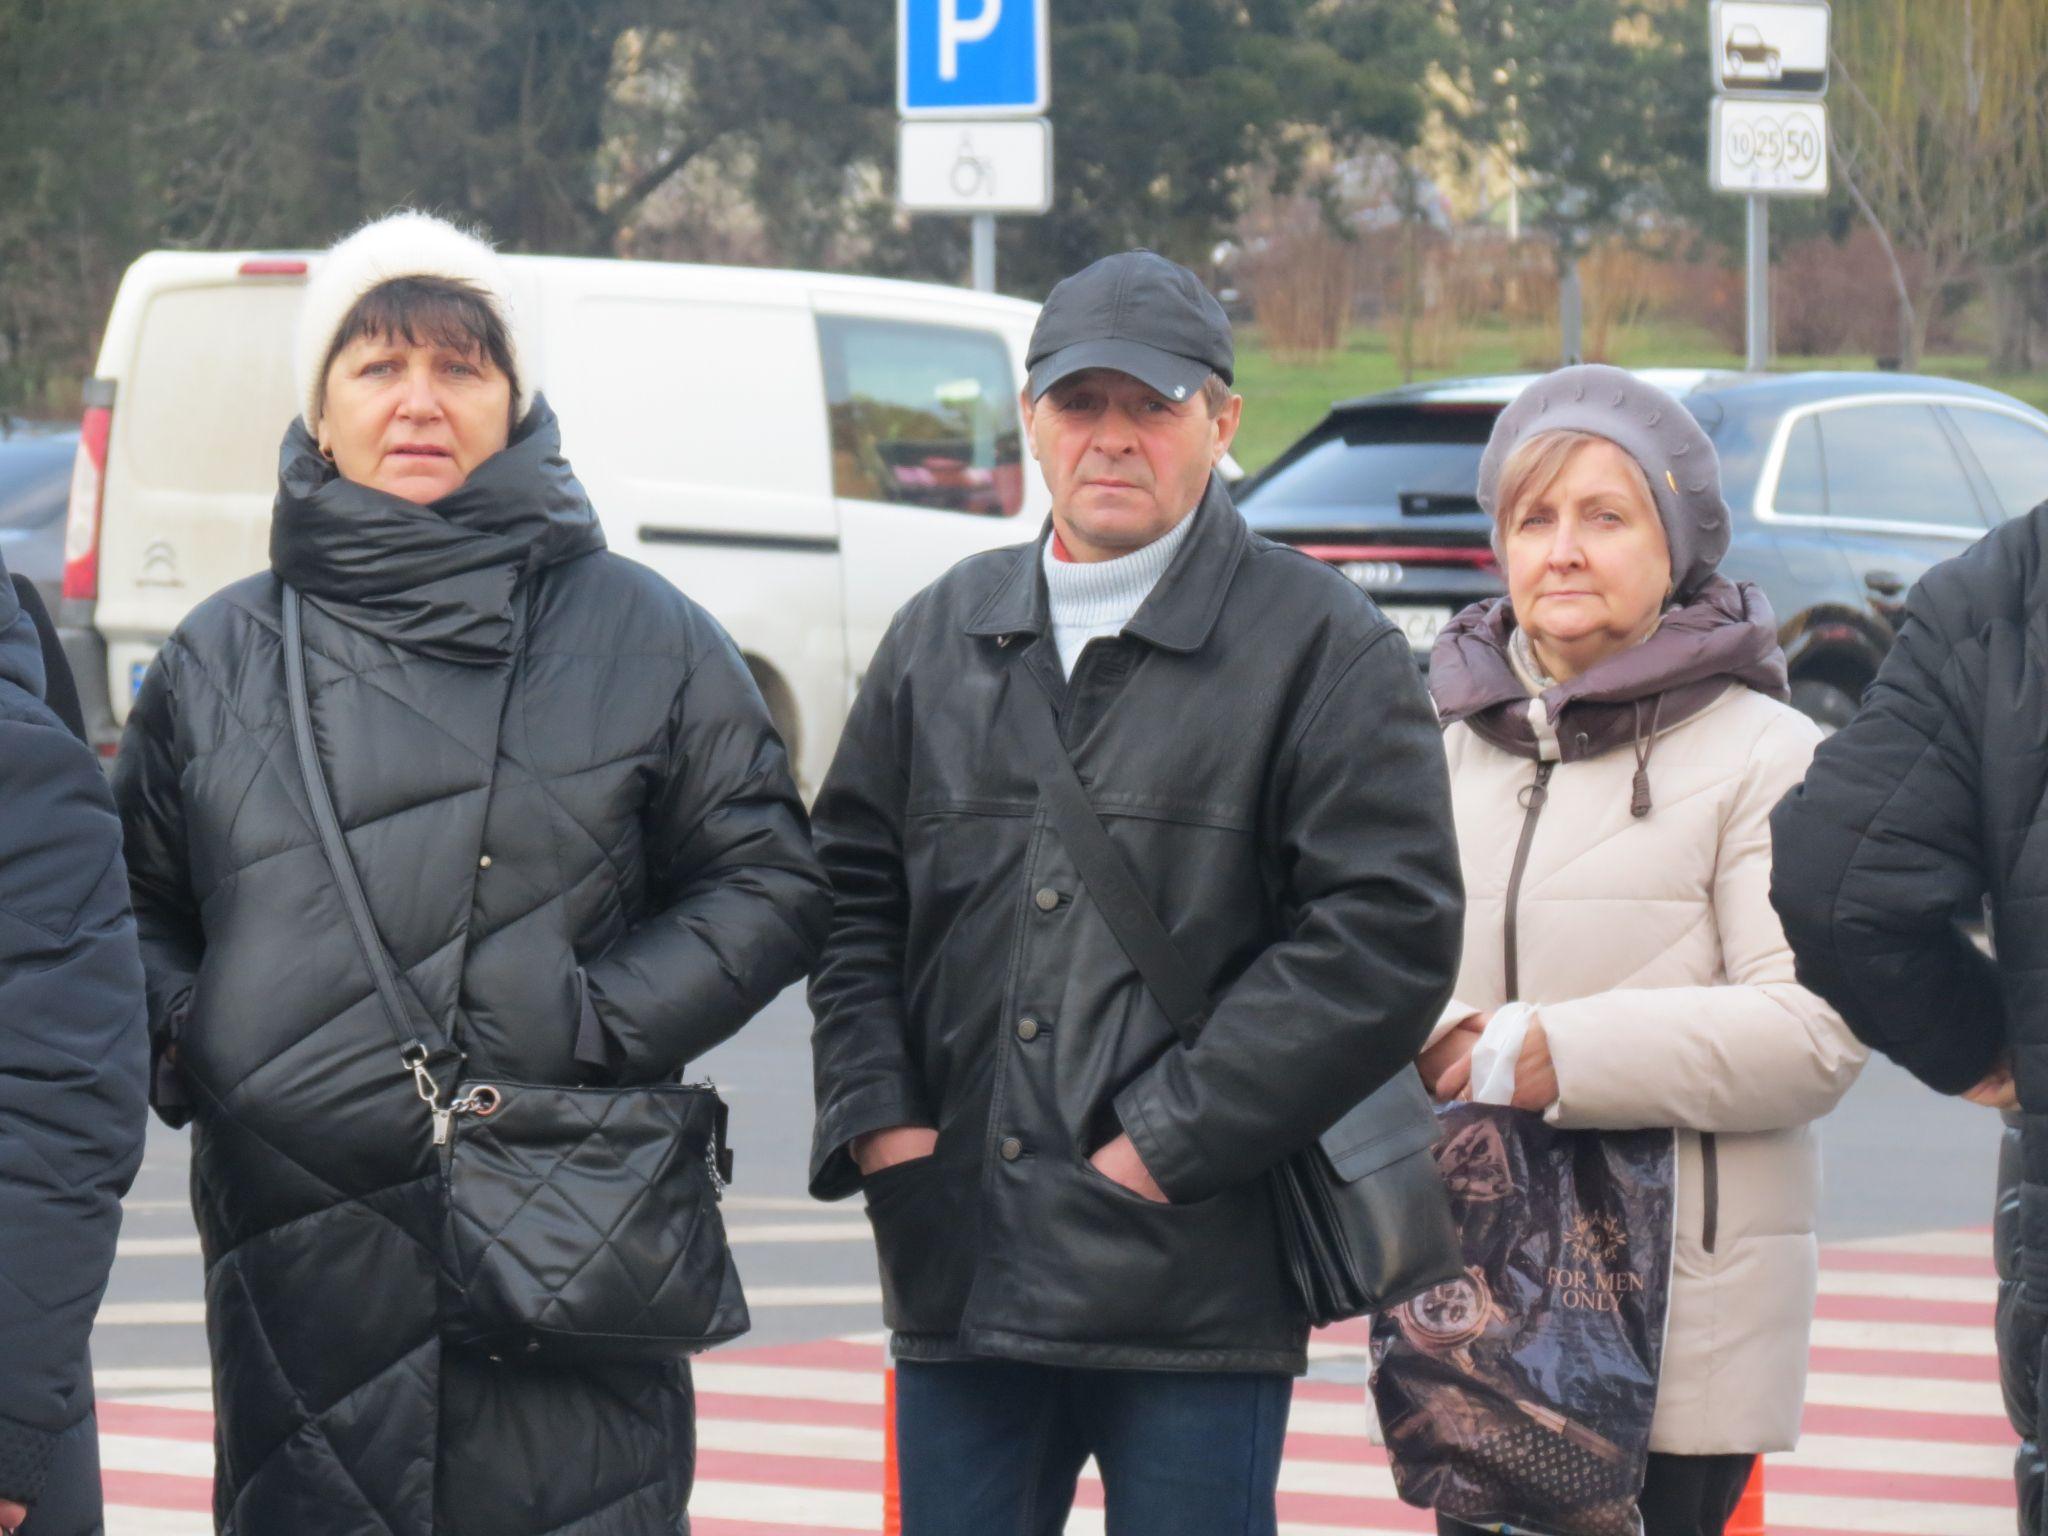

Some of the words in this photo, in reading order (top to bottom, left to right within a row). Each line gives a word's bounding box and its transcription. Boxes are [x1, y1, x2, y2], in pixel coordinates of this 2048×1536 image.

[938, 0, 1003, 80] P
[1732, 132, 1750, 156] 10
[1754, 130, 1780, 157] 25
[1784, 129, 1814, 161] 50
[1547, 1266, 1588, 1290] FOR
[1596, 1271, 1644, 1292] MEN
[1562, 1289, 1624, 1312] ONLY
